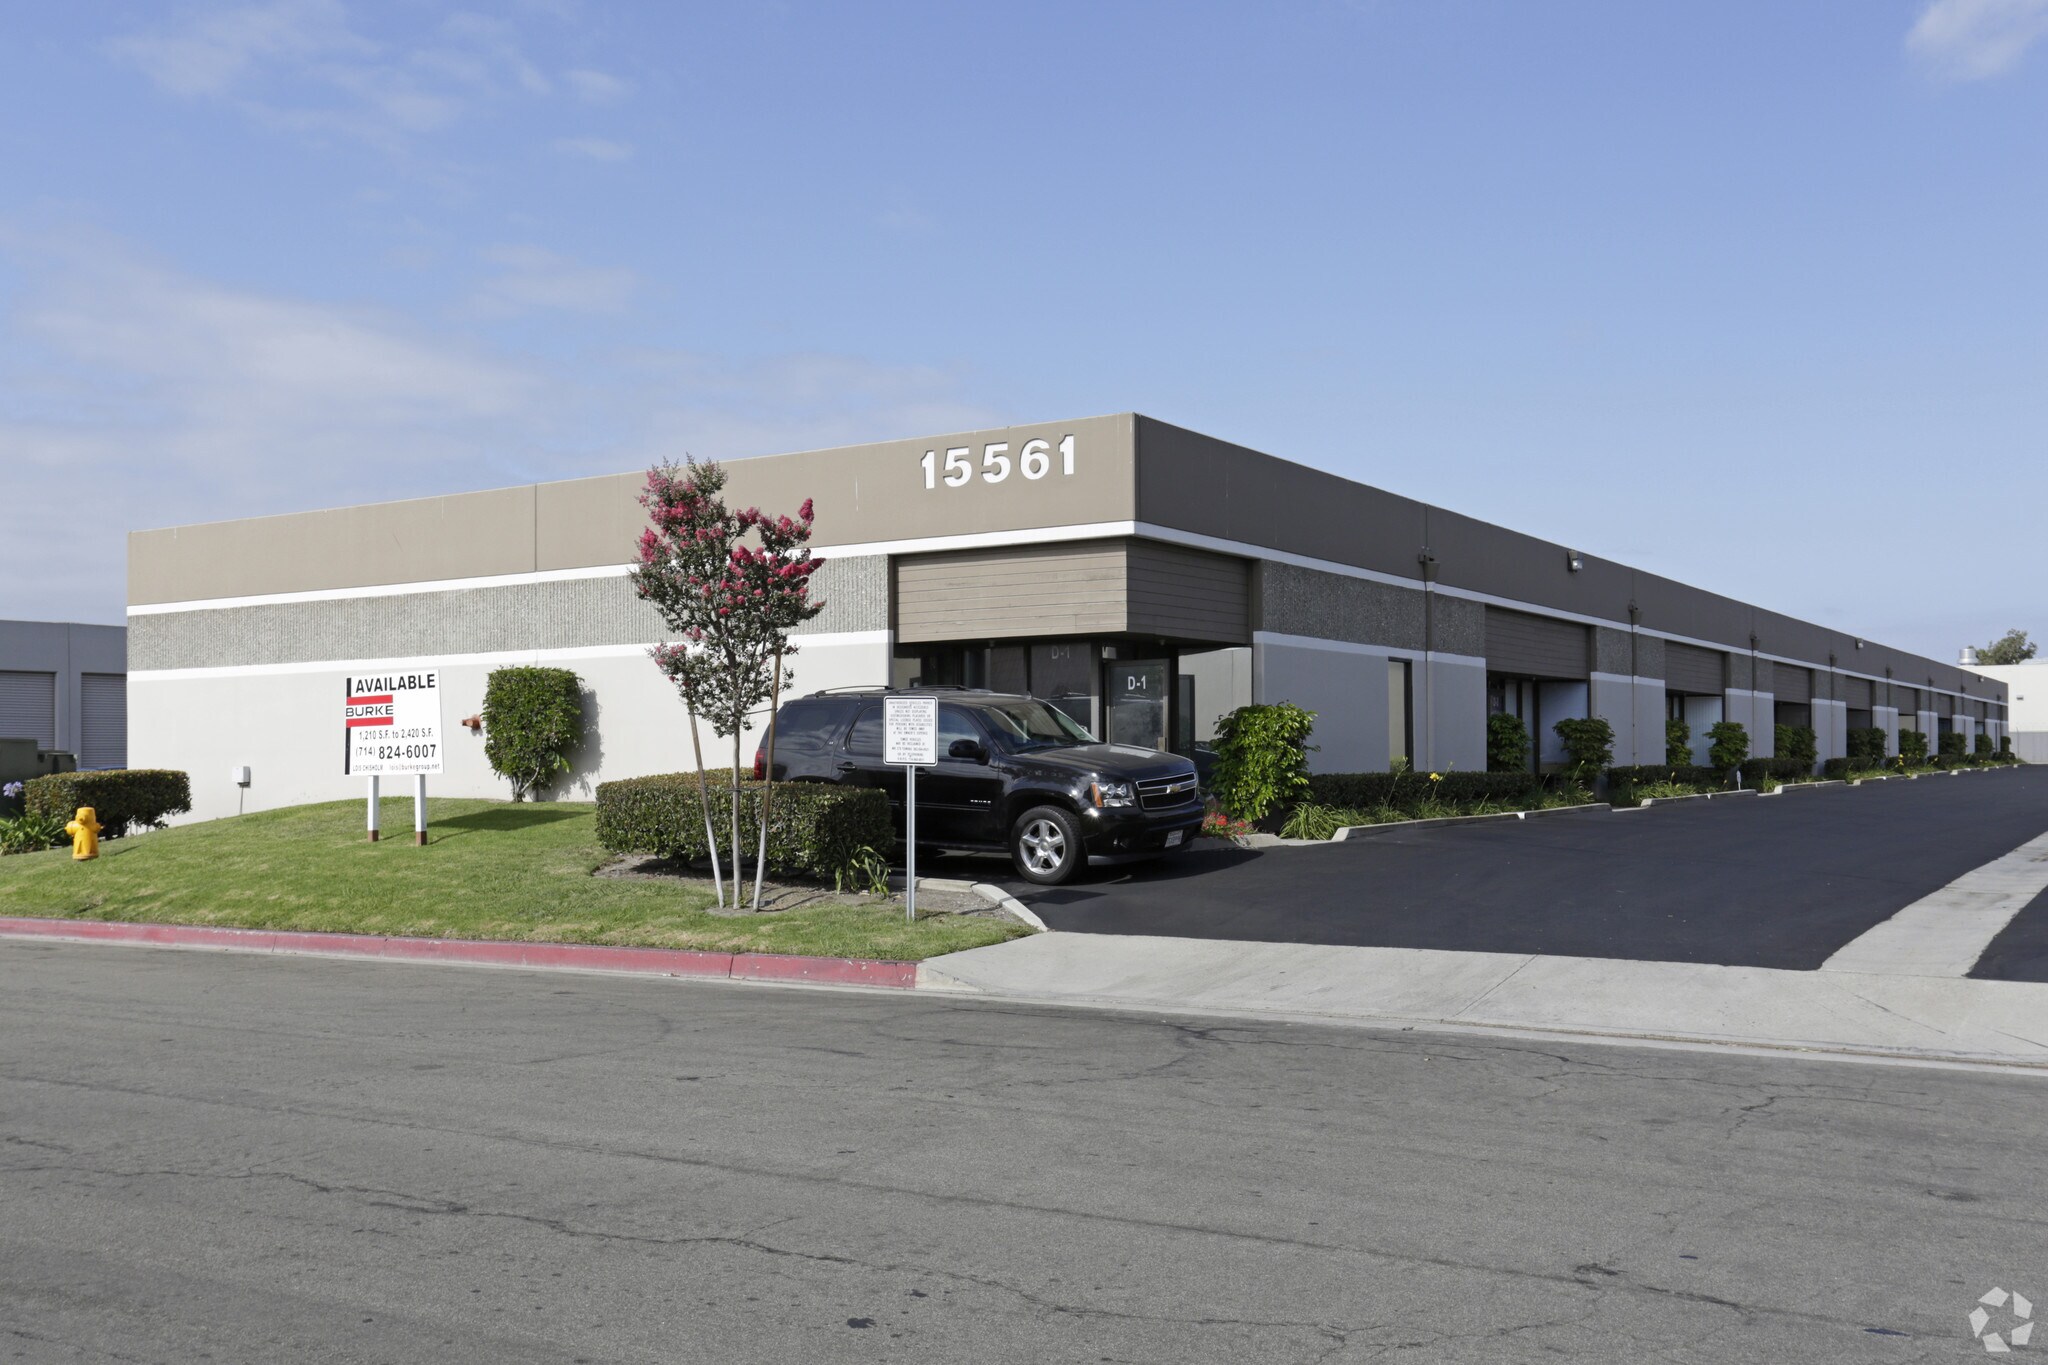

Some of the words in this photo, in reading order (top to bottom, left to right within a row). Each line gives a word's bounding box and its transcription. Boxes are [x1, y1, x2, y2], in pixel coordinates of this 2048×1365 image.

[921, 434, 1074, 489] 15561
[1051, 646, 1070, 659] D-1
[355, 673, 436, 693] AVAILABLE
[1127, 675, 1146, 690] D-1
[345, 705, 394, 717] BURKE
[359, 730, 377, 741] 1,210
[378, 729, 391, 740] S.F.
[392, 730, 399, 739] to
[401, 728, 420, 740] 2,420
[421, 727, 434, 738] S.F.
[355, 746, 376, 757] (714)
[378, 744, 437, 760] 824-6007
